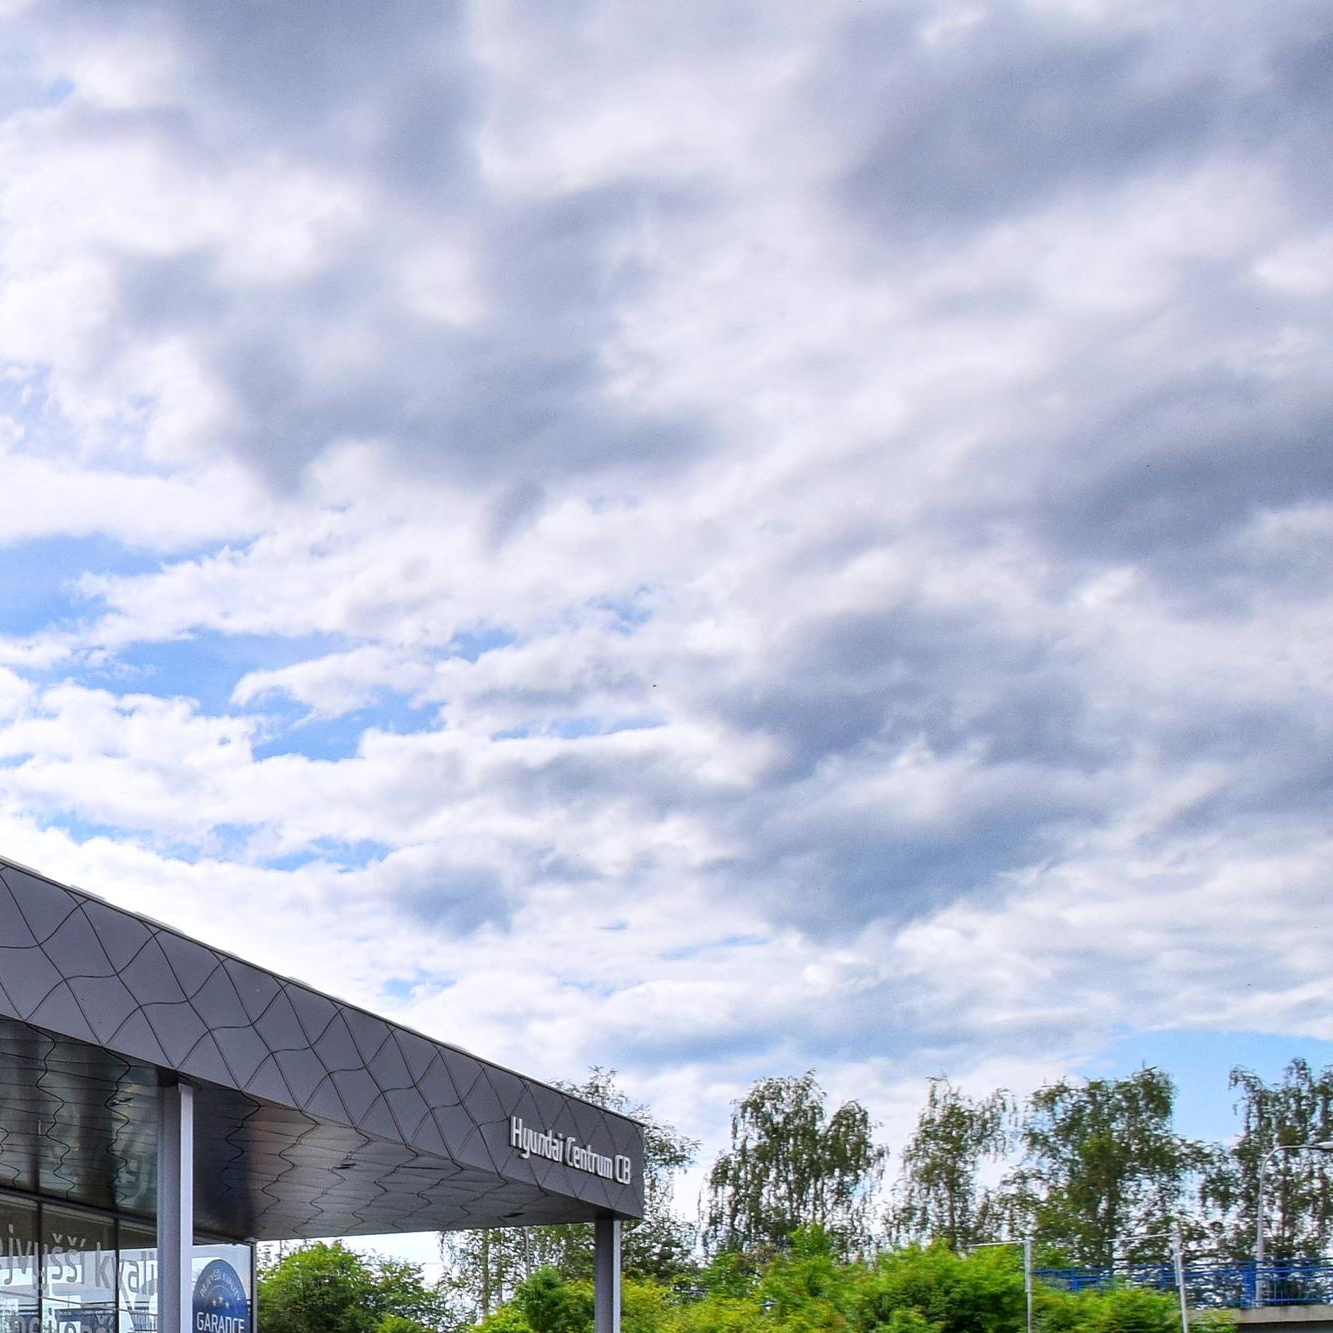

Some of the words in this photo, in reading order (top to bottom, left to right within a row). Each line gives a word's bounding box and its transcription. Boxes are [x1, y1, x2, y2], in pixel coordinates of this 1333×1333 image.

[510, 1116, 564, 1162] Hyundai
[565, 1136, 613, 1179] Centrum
[614, 1154, 631, 1185] CB
